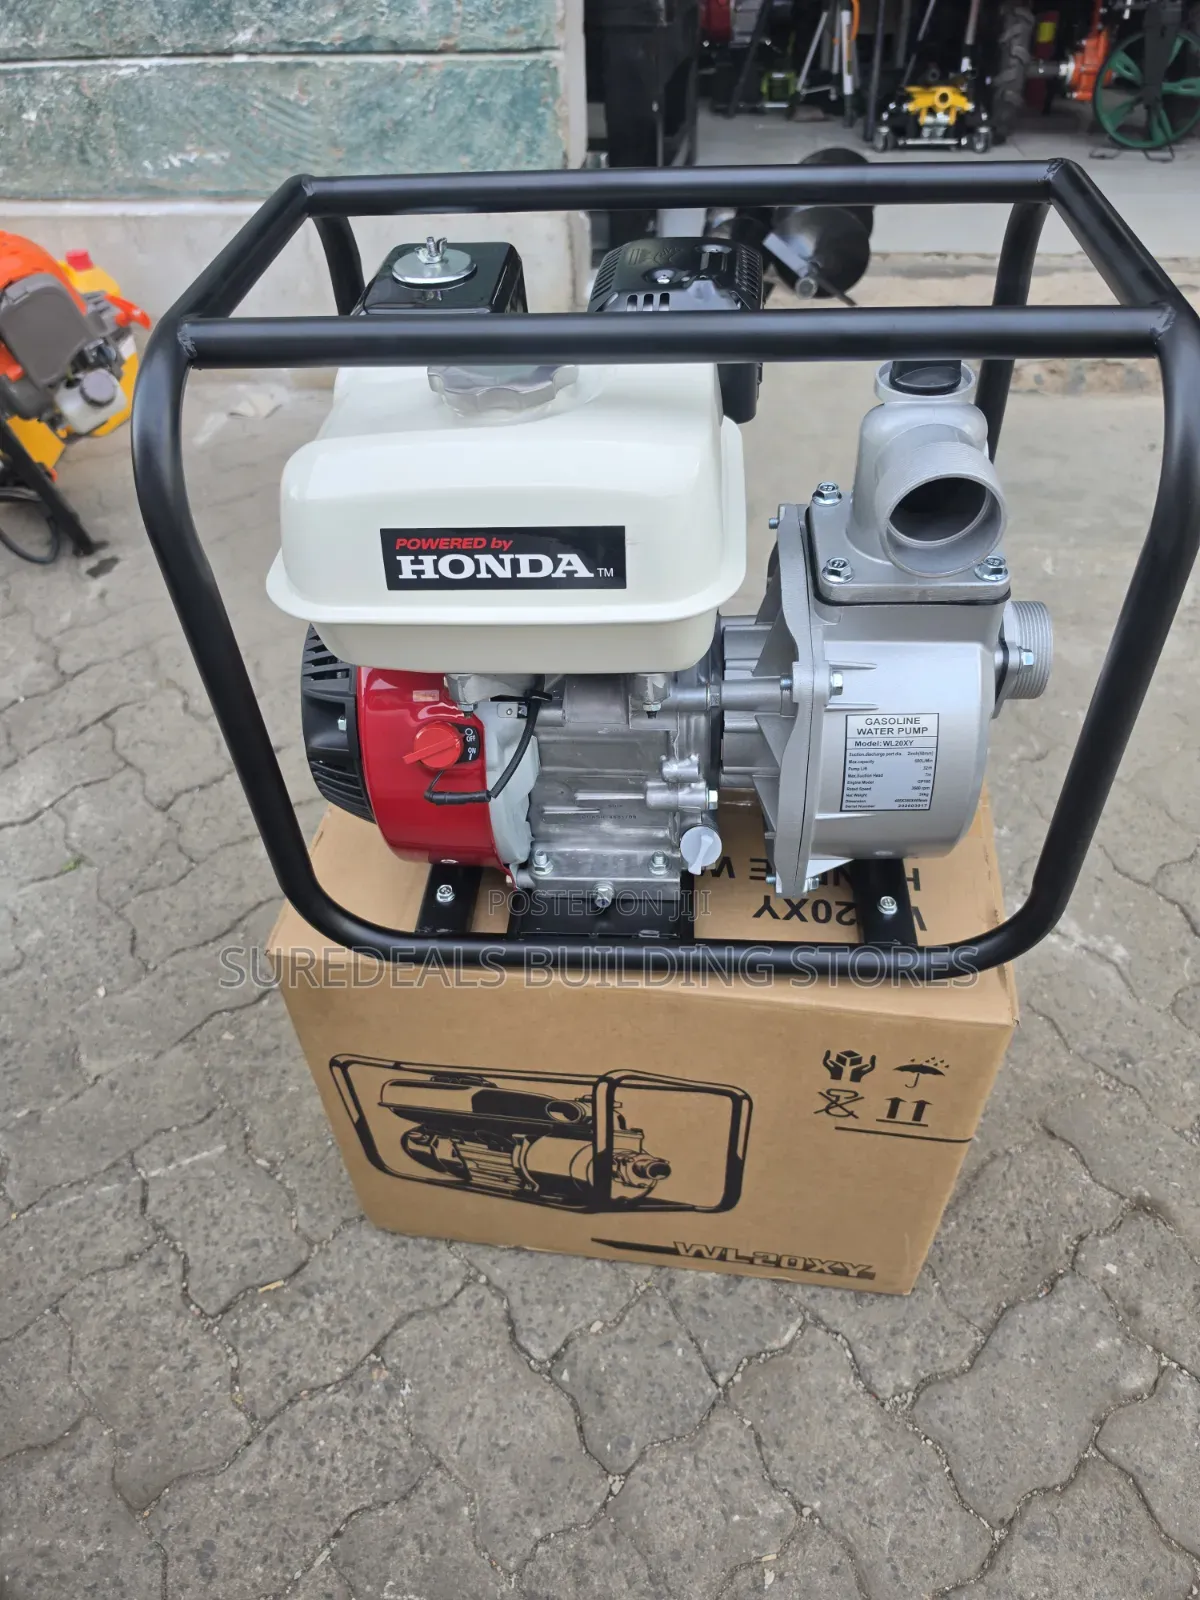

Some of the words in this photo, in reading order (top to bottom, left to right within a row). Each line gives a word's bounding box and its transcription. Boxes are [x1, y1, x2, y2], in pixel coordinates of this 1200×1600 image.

[395, 537, 487, 550] POWERED
[490, 537, 513, 552] by
[396, 553, 594, 579] HONDA
[865, 717, 920, 725] GASOLINE
[857, 727, 894, 735] WATER
[897, 726, 928, 735] PUMP
[673, 1241, 874, 1278] WL20XY
